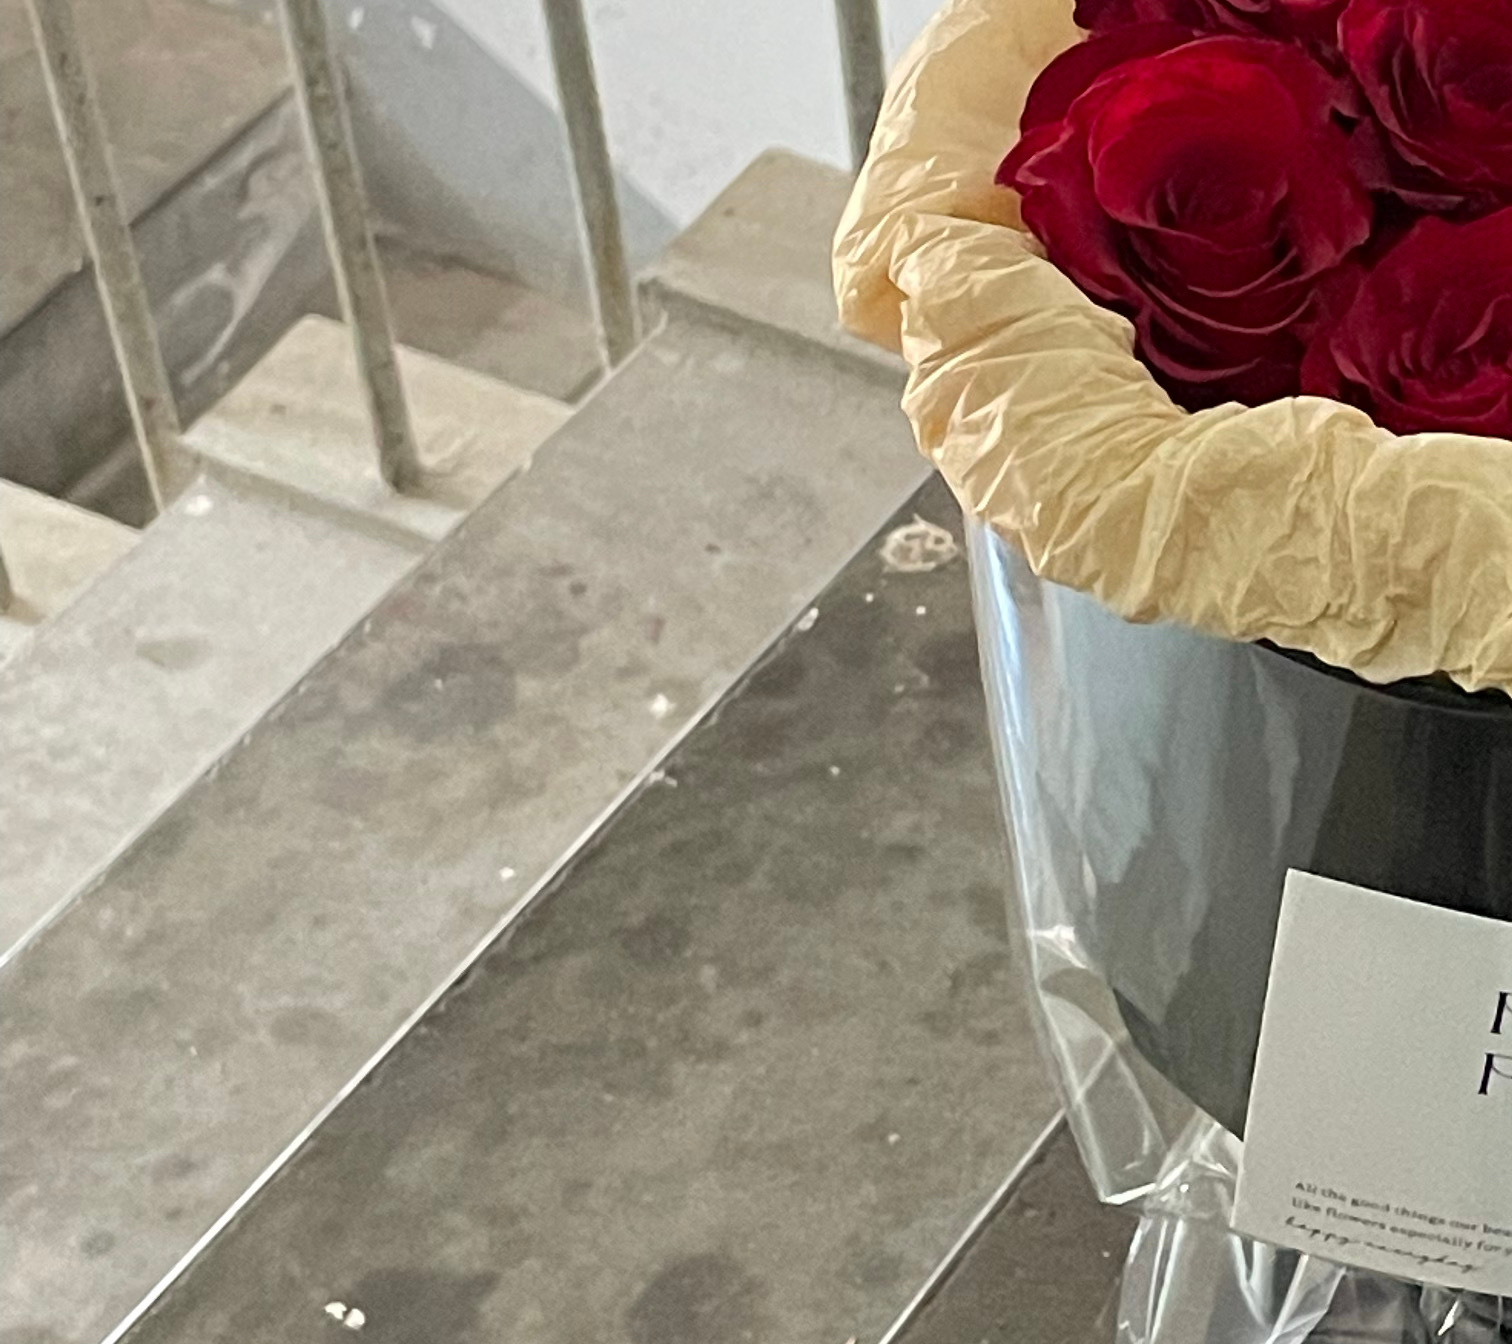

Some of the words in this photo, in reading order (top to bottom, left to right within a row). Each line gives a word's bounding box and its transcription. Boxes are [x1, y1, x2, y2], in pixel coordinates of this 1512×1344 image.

[1321, 1188, 1347, 1202] the
[1325, 1207, 1386, 1230] flowers
[1389, 1225, 1473, 1251] especially
[1476, 1239, 1502, 1252] for
